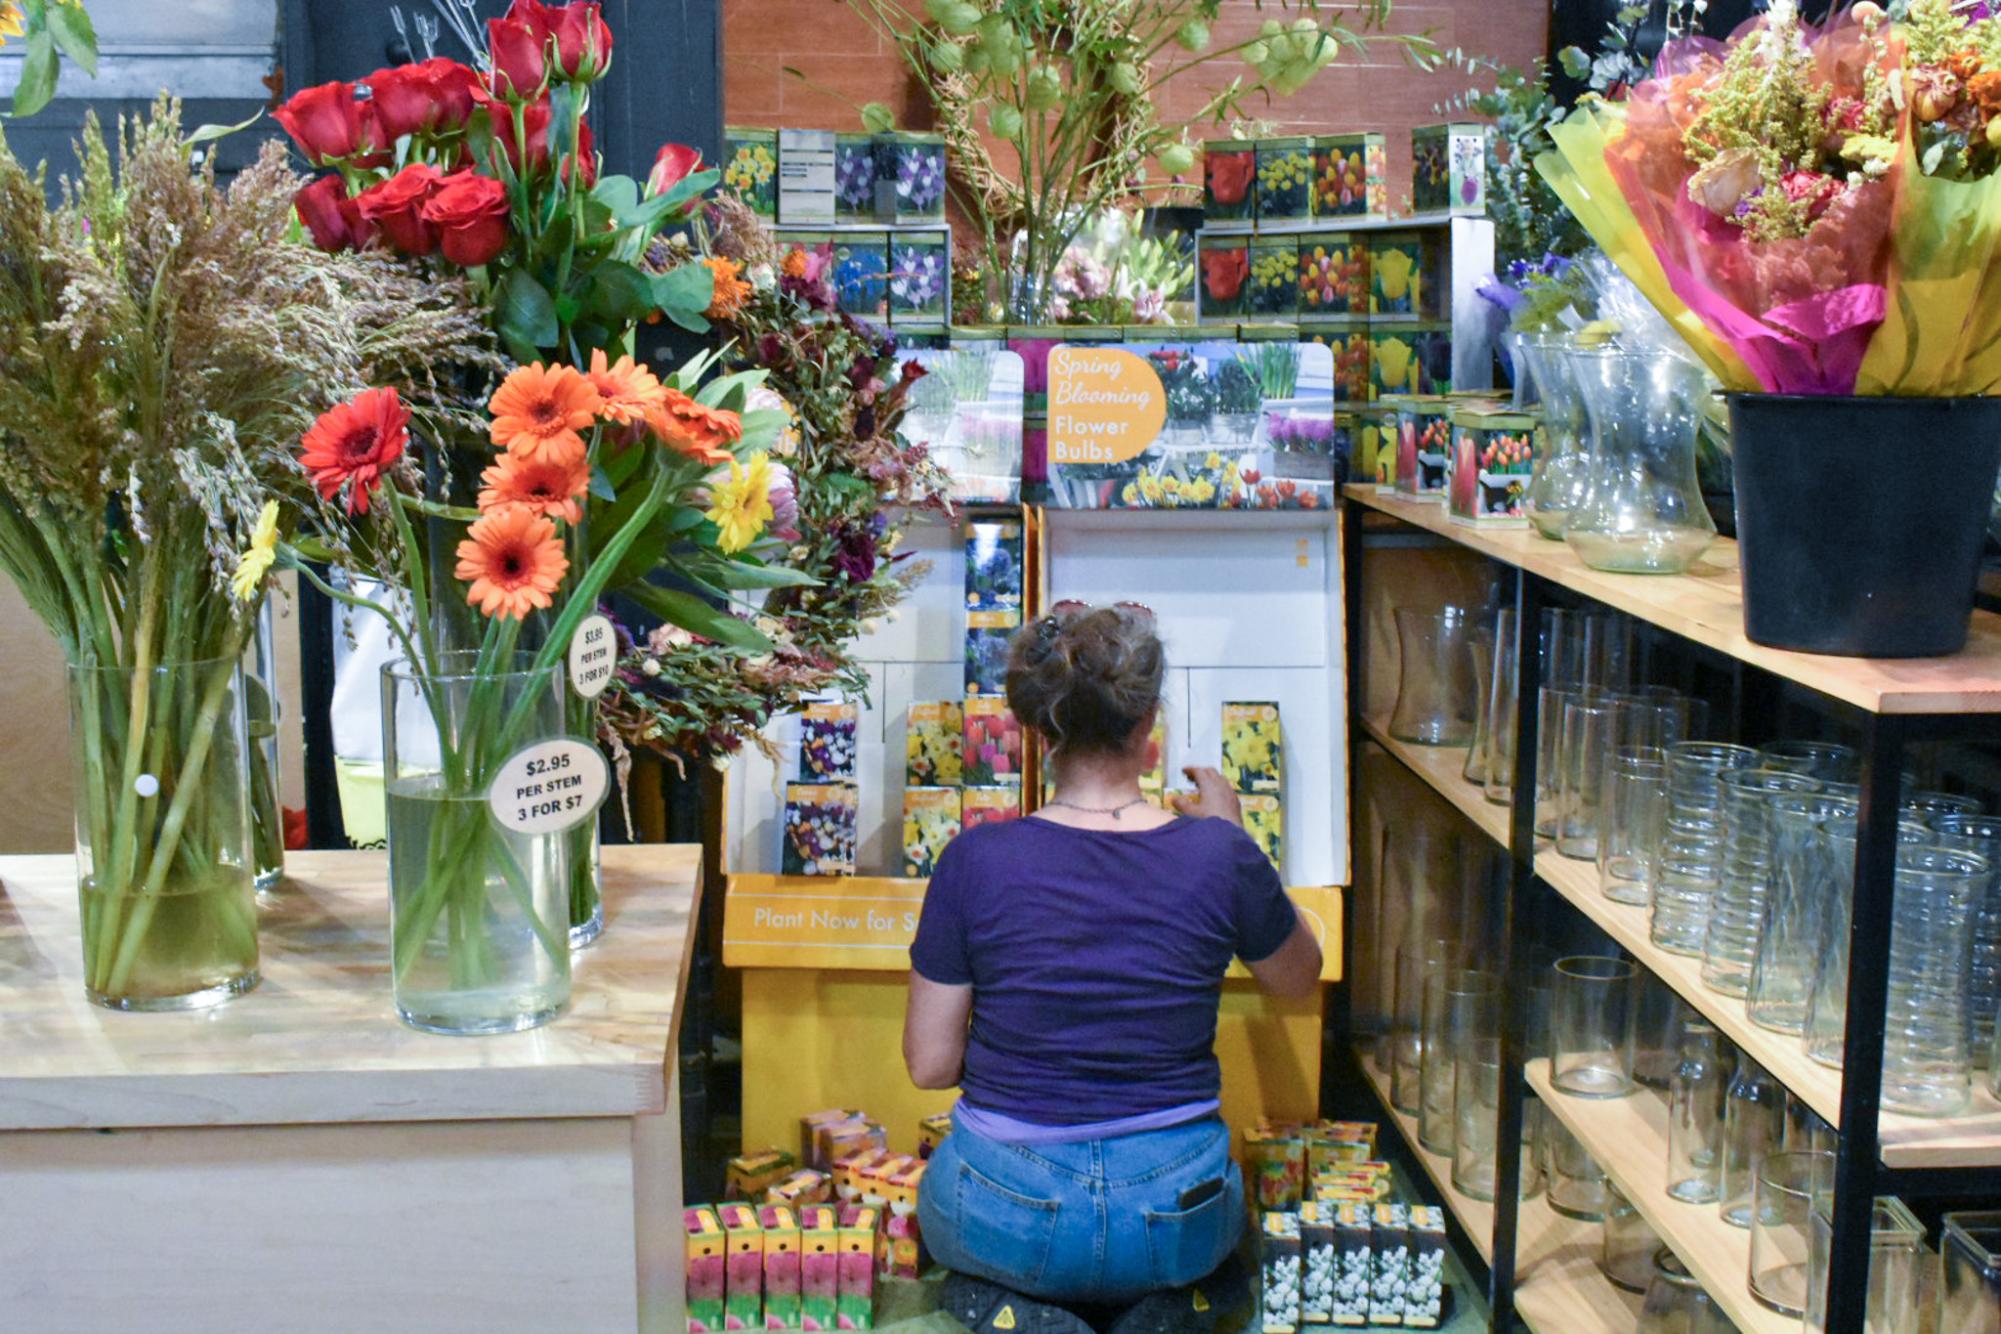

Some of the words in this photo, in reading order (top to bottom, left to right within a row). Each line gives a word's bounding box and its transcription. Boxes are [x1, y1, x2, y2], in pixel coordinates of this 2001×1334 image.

[1055, 351, 1122, 380] Spring
[1055, 381, 1151, 411] Blooming
[1055, 415, 1129, 434] Flower
[1055, 439, 1114, 460] Bulbs
[526, 753, 571, 776] $2.95
[516, 783, 543, 799] PER
[546, 774, 582, 792] STEM
[518, 808, 527, 821] 3
[531, 800, 562, 818] FOR
[565, 794, 583, 810] $7
[754, 906, 804, 928] Plant
[811, 910, 860, 930] Now
[867, 909, 896, 931] for
